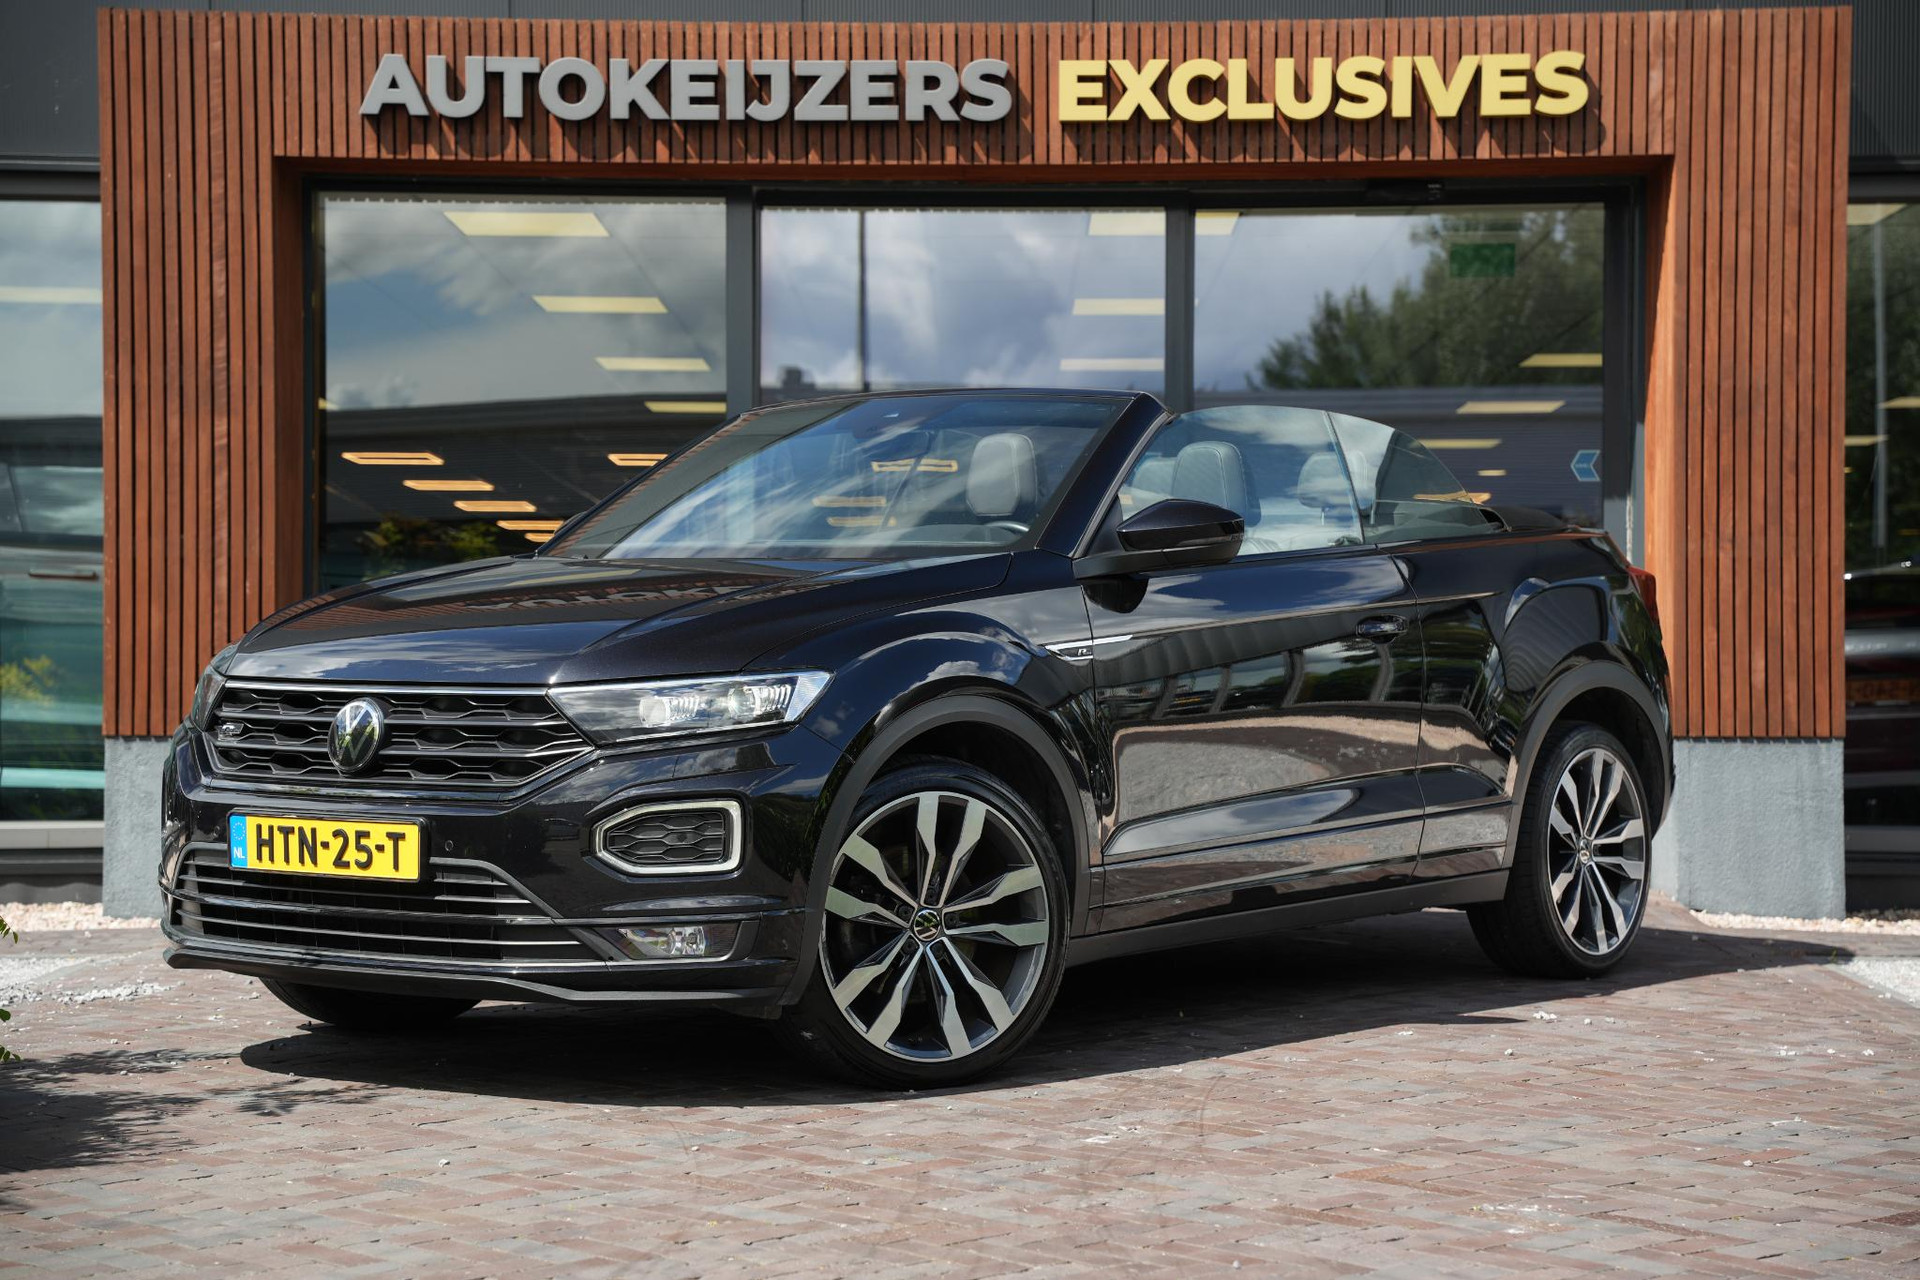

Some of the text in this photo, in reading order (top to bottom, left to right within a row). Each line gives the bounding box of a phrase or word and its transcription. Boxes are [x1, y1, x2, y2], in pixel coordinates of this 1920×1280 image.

[359, 50, 1589, 122] AUTOKEIJZERS EXCLUSIVES
[233, 846, 246, 859] NL
[255, 823, 406, 872] HTN-25-T
